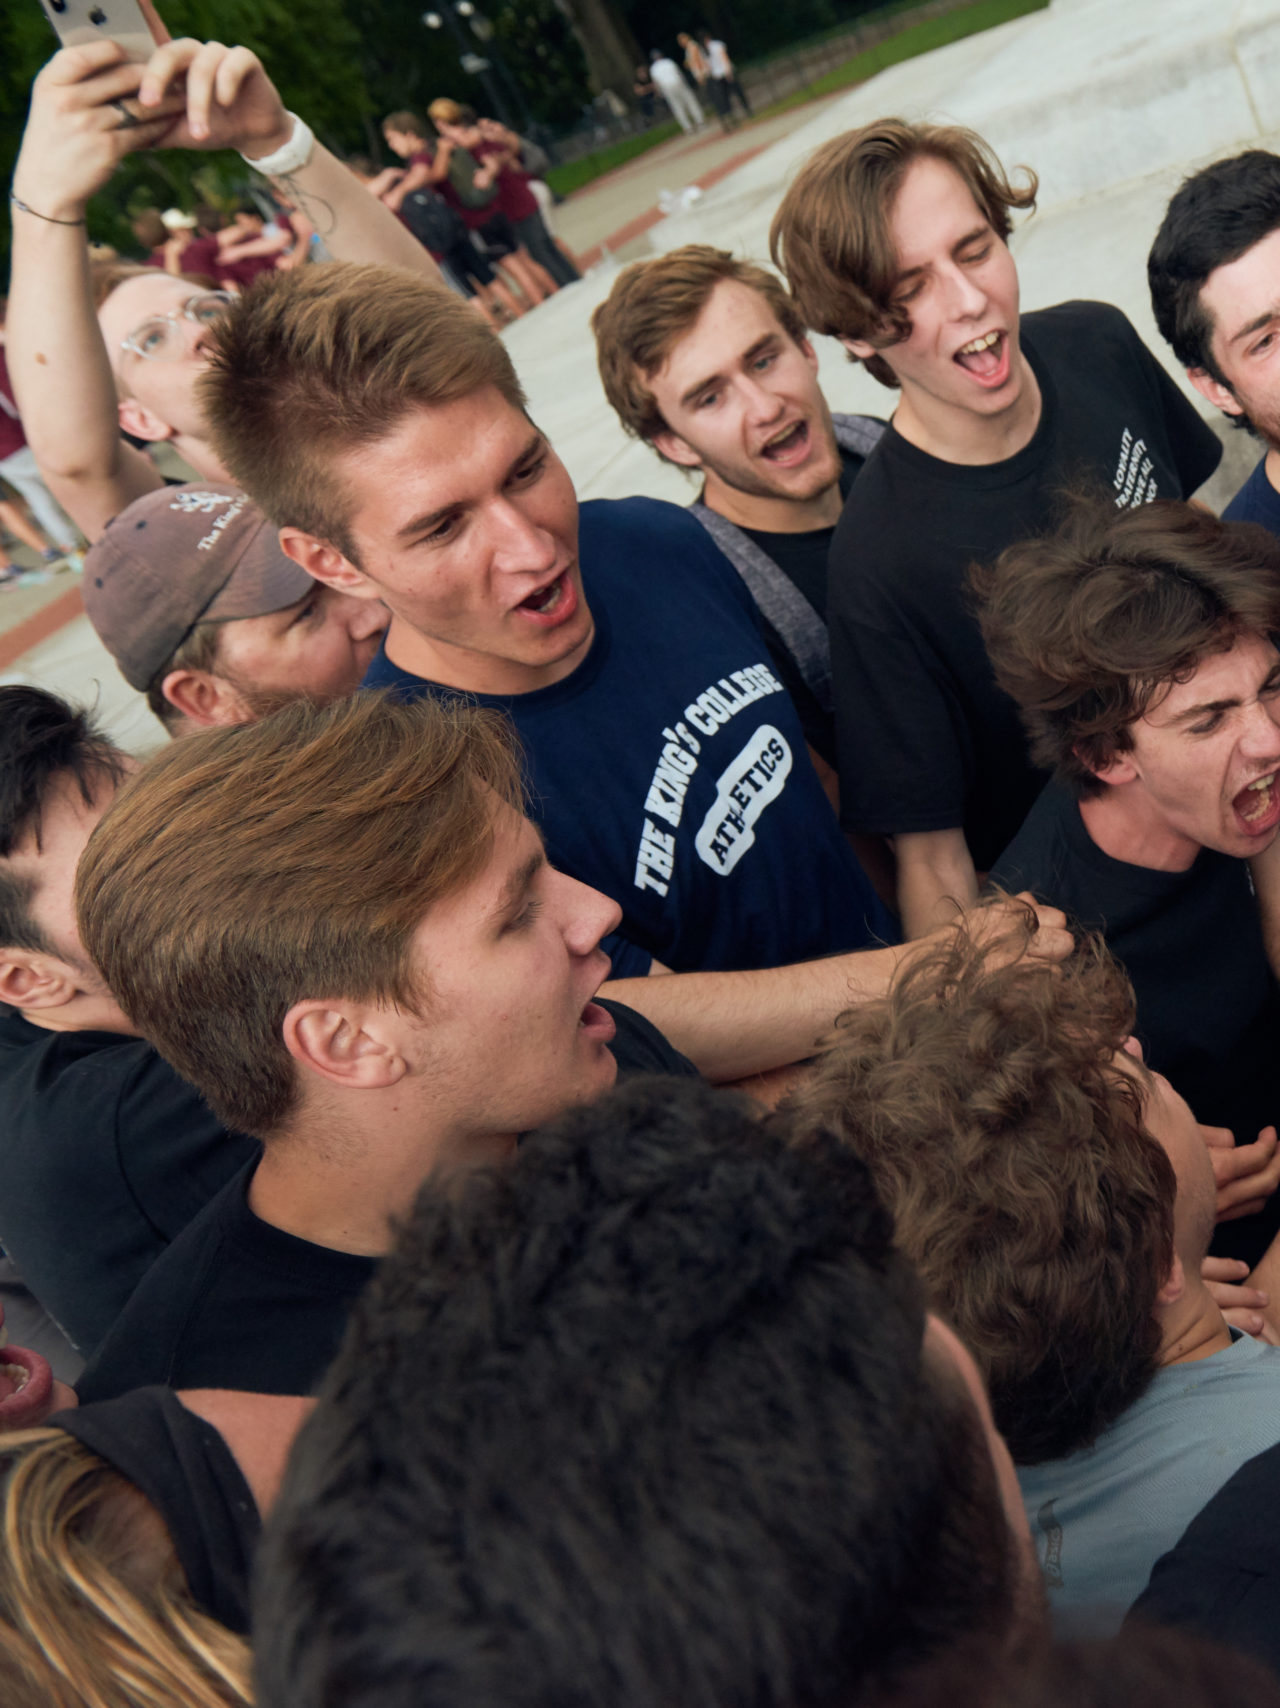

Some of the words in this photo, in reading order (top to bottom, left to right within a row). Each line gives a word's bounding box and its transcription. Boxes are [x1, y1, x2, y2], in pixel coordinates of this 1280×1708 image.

[197, 529, 221, 551] The
[634, 817, 676, 898] THE
[684, 663, 784, 736] COLLEGE
[709, 738, 785, 866] ATHLETICS
